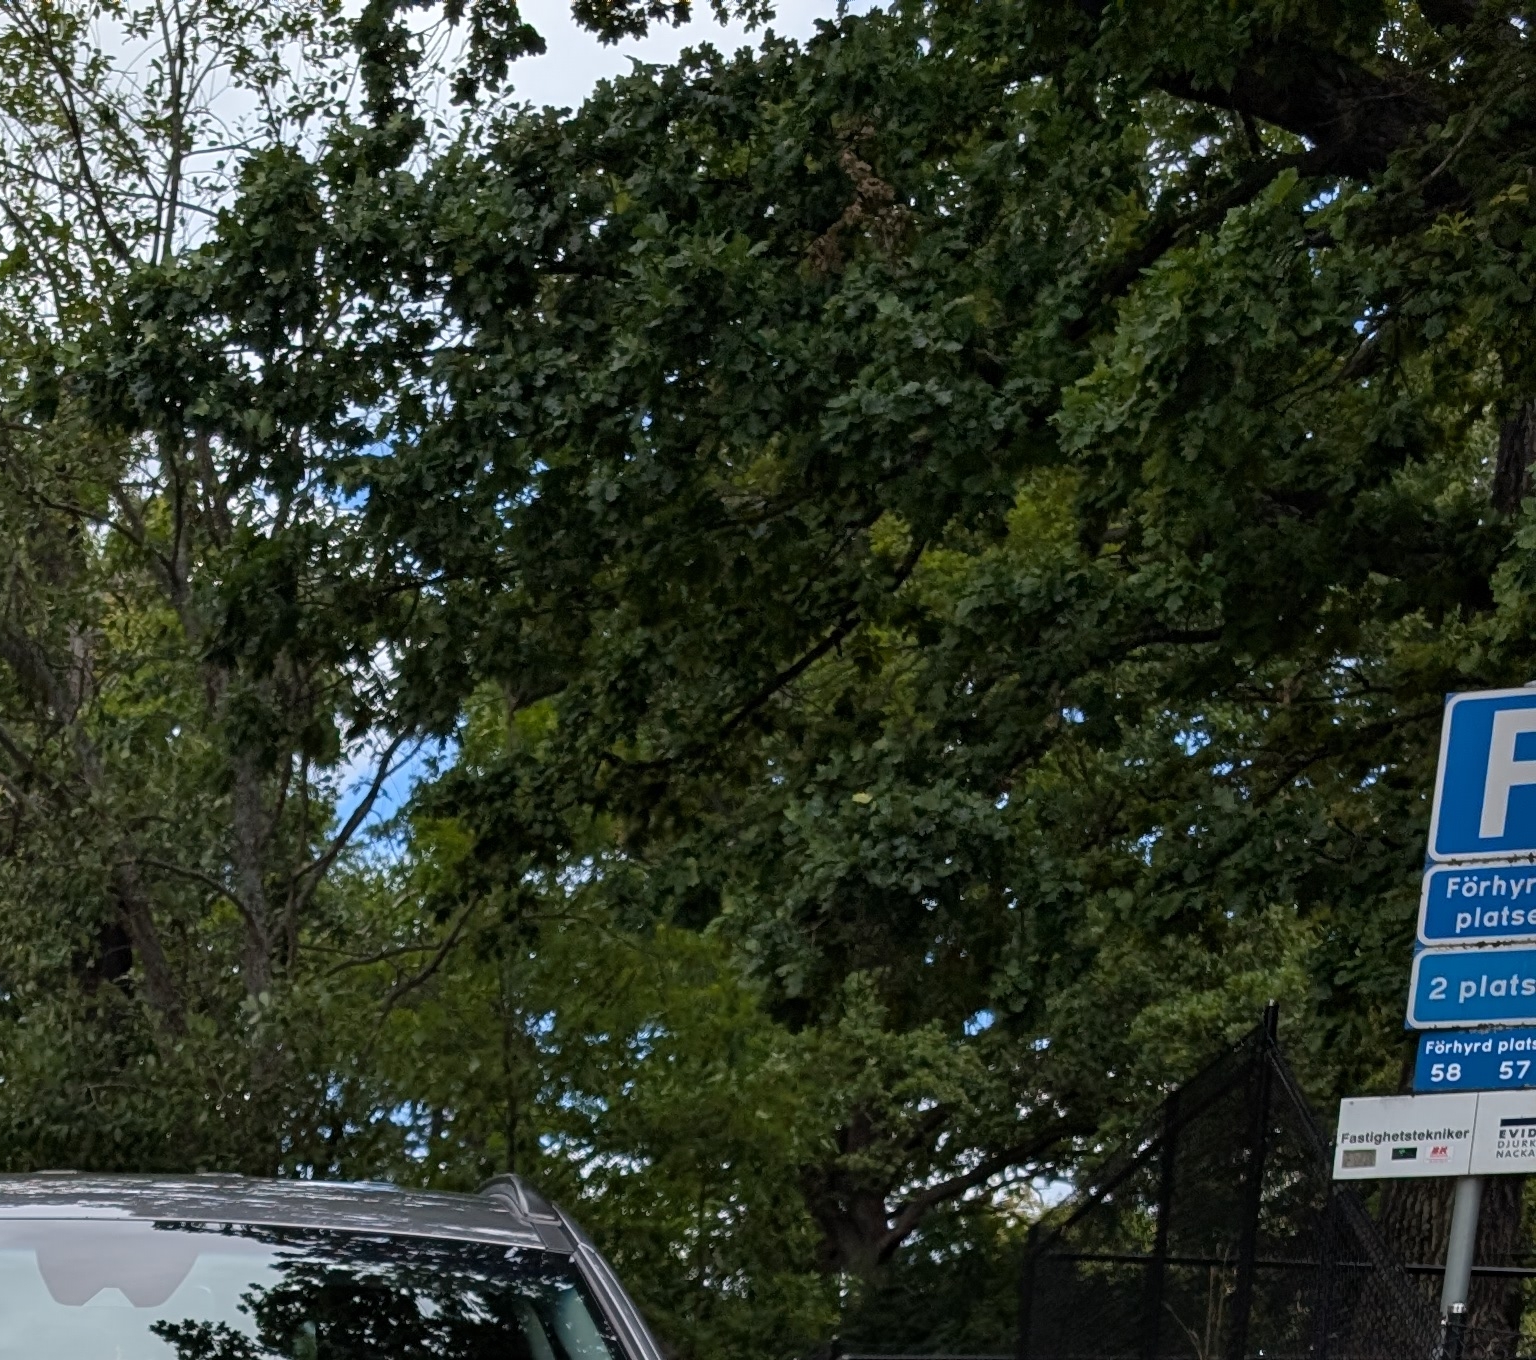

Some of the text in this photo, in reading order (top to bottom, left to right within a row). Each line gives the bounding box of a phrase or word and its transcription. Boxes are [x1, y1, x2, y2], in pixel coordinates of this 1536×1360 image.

[1446, 874, 1536, 900] Förhyr
[1428, 974, 1536, 1003] 2 plats
[1425, 1038, 1493, 1056] Förhyrd
[1430, 1060, 1531, 1082] 58 57
[1341, 1128, 1470, 1145] Fastighetstekniker
[1499, 1128, 1536, 1139] EVID
[1497, 1139, 1536, 1149] DJURK
[1495, 1149, 1536, 1159] NACKA
